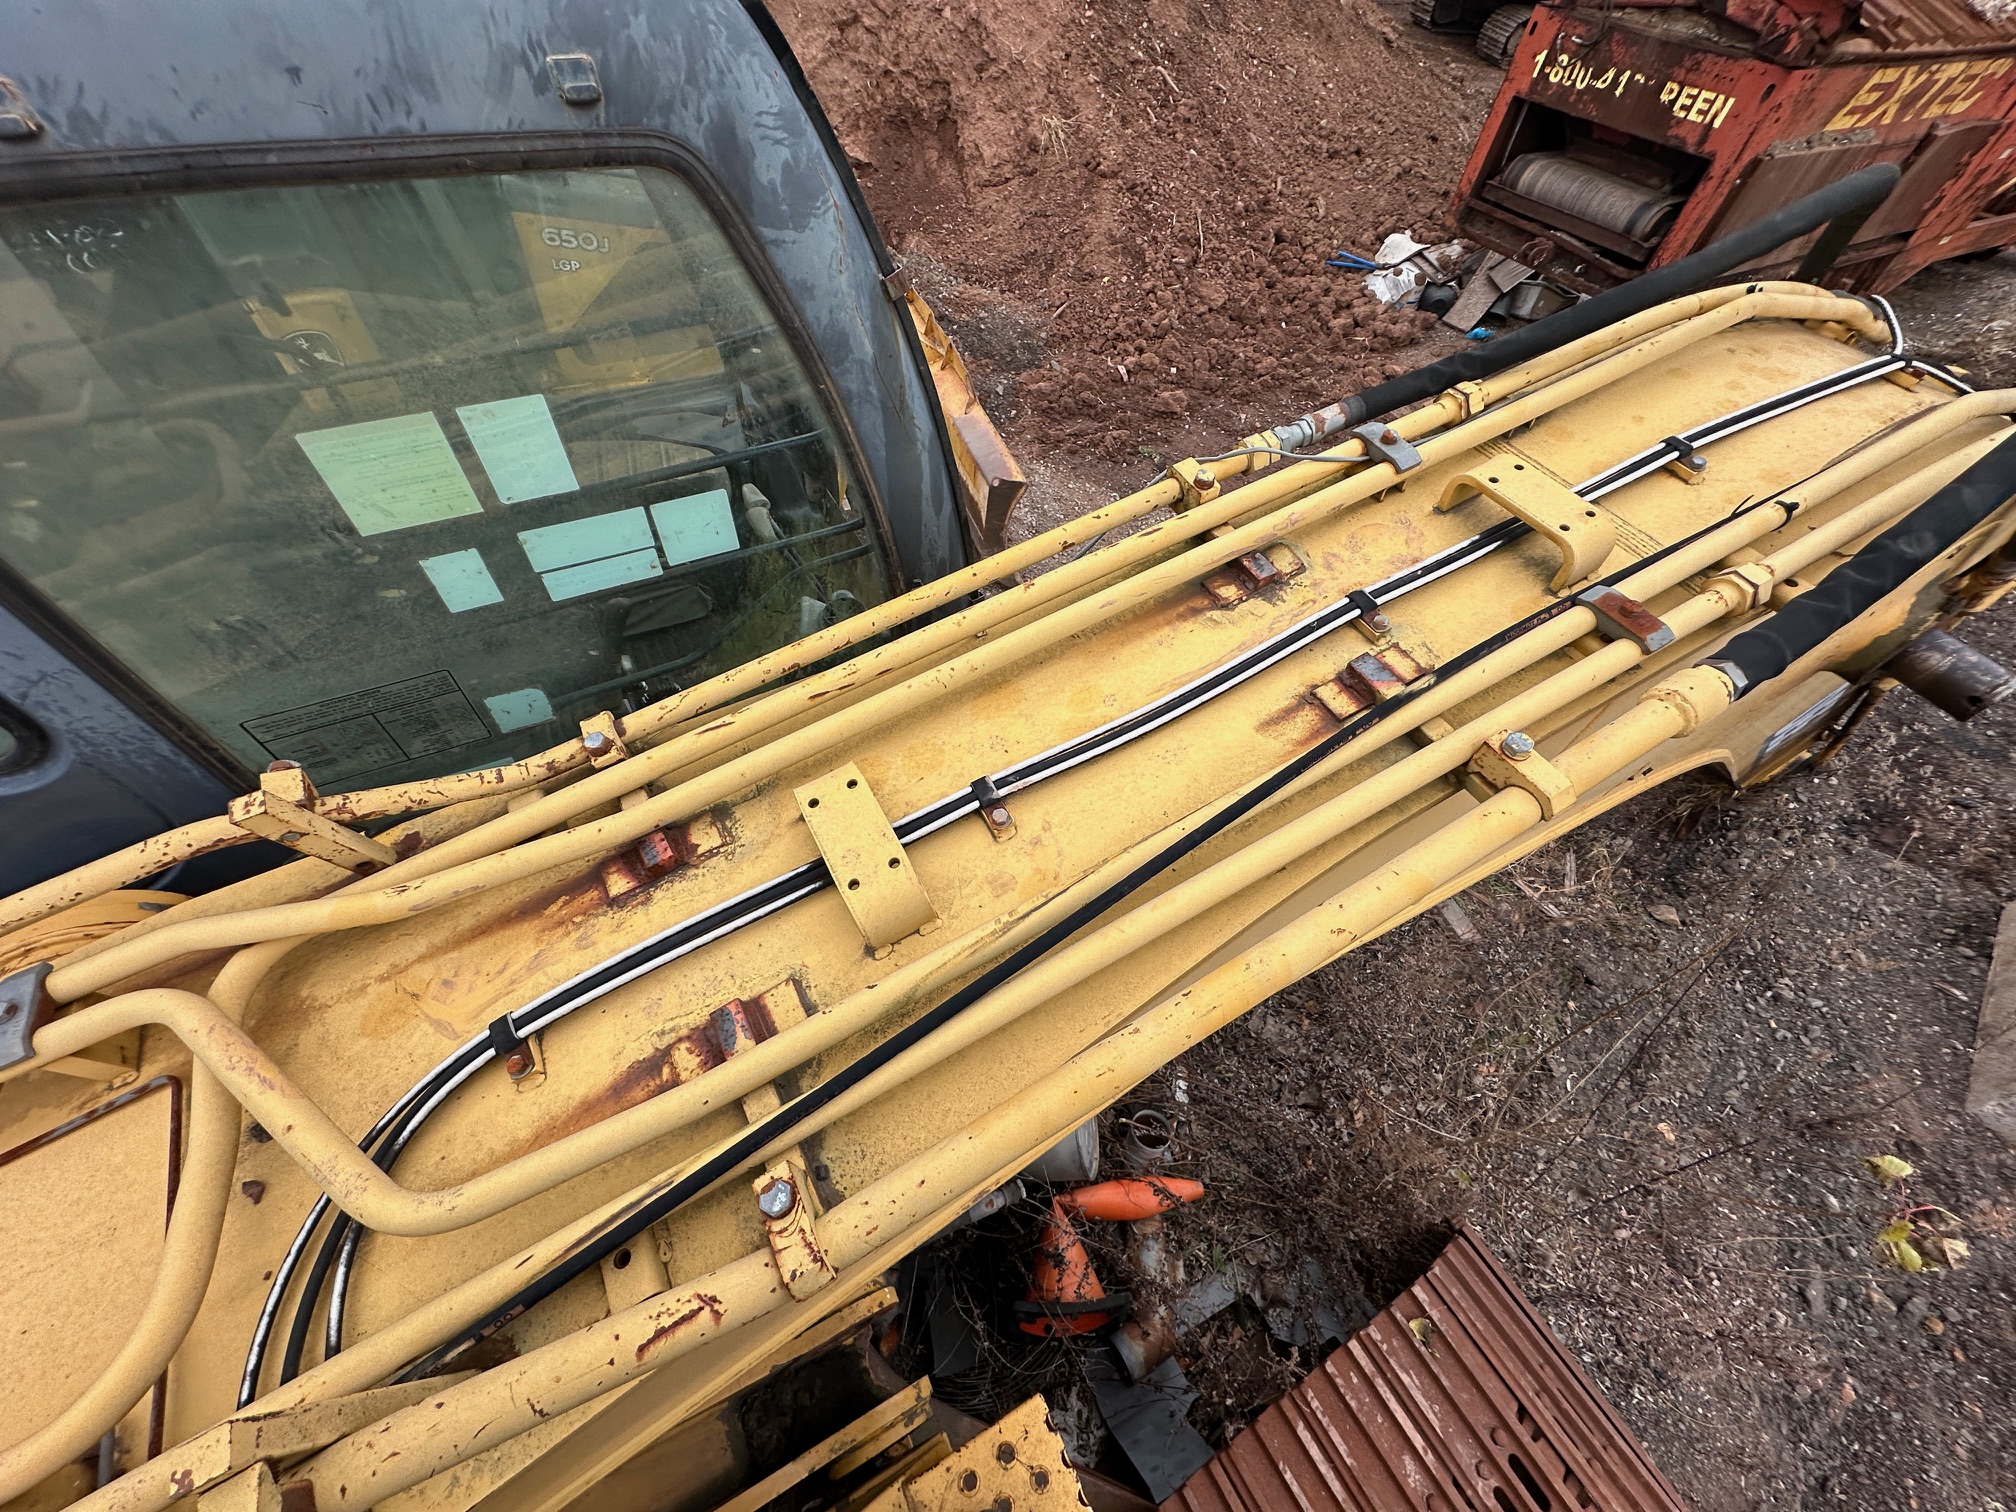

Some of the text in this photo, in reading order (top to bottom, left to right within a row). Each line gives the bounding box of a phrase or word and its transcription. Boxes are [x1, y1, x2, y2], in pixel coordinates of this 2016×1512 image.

[1823, 57, 2014, 131] EXTEC
[541, 227, 611, 254] 650J
[551, 258, 581, 272] LGP
